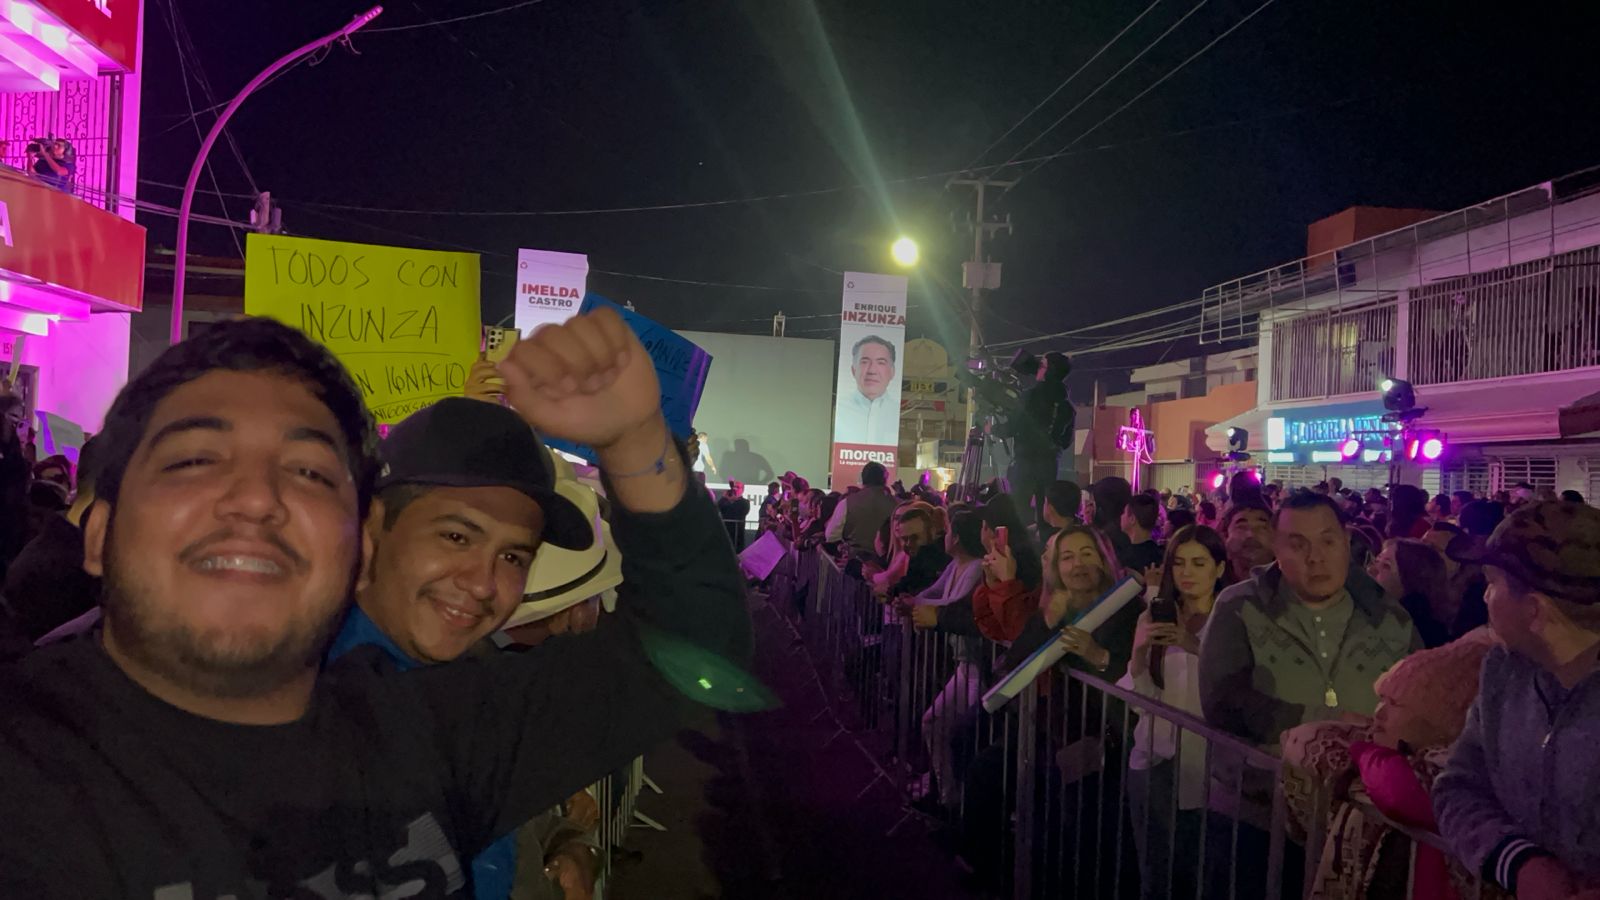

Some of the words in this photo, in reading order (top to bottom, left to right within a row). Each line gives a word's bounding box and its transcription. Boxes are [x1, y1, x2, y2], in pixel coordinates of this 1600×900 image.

[267, 246, 370, 289] TODOS
[397, 259, 458, 288] CON
[522, 283, 580, 299] IMELDA
[528, 296, 573, 308] CASTRO
[854, 302, 897, 314] ENRIQUE
[301, 301, 439, 344] INZUNZA
[843, 310, 906, 326] INZUNZA
[385, 362, 466, 395] IGNACIO
[839, 448, 895, 463] morena
